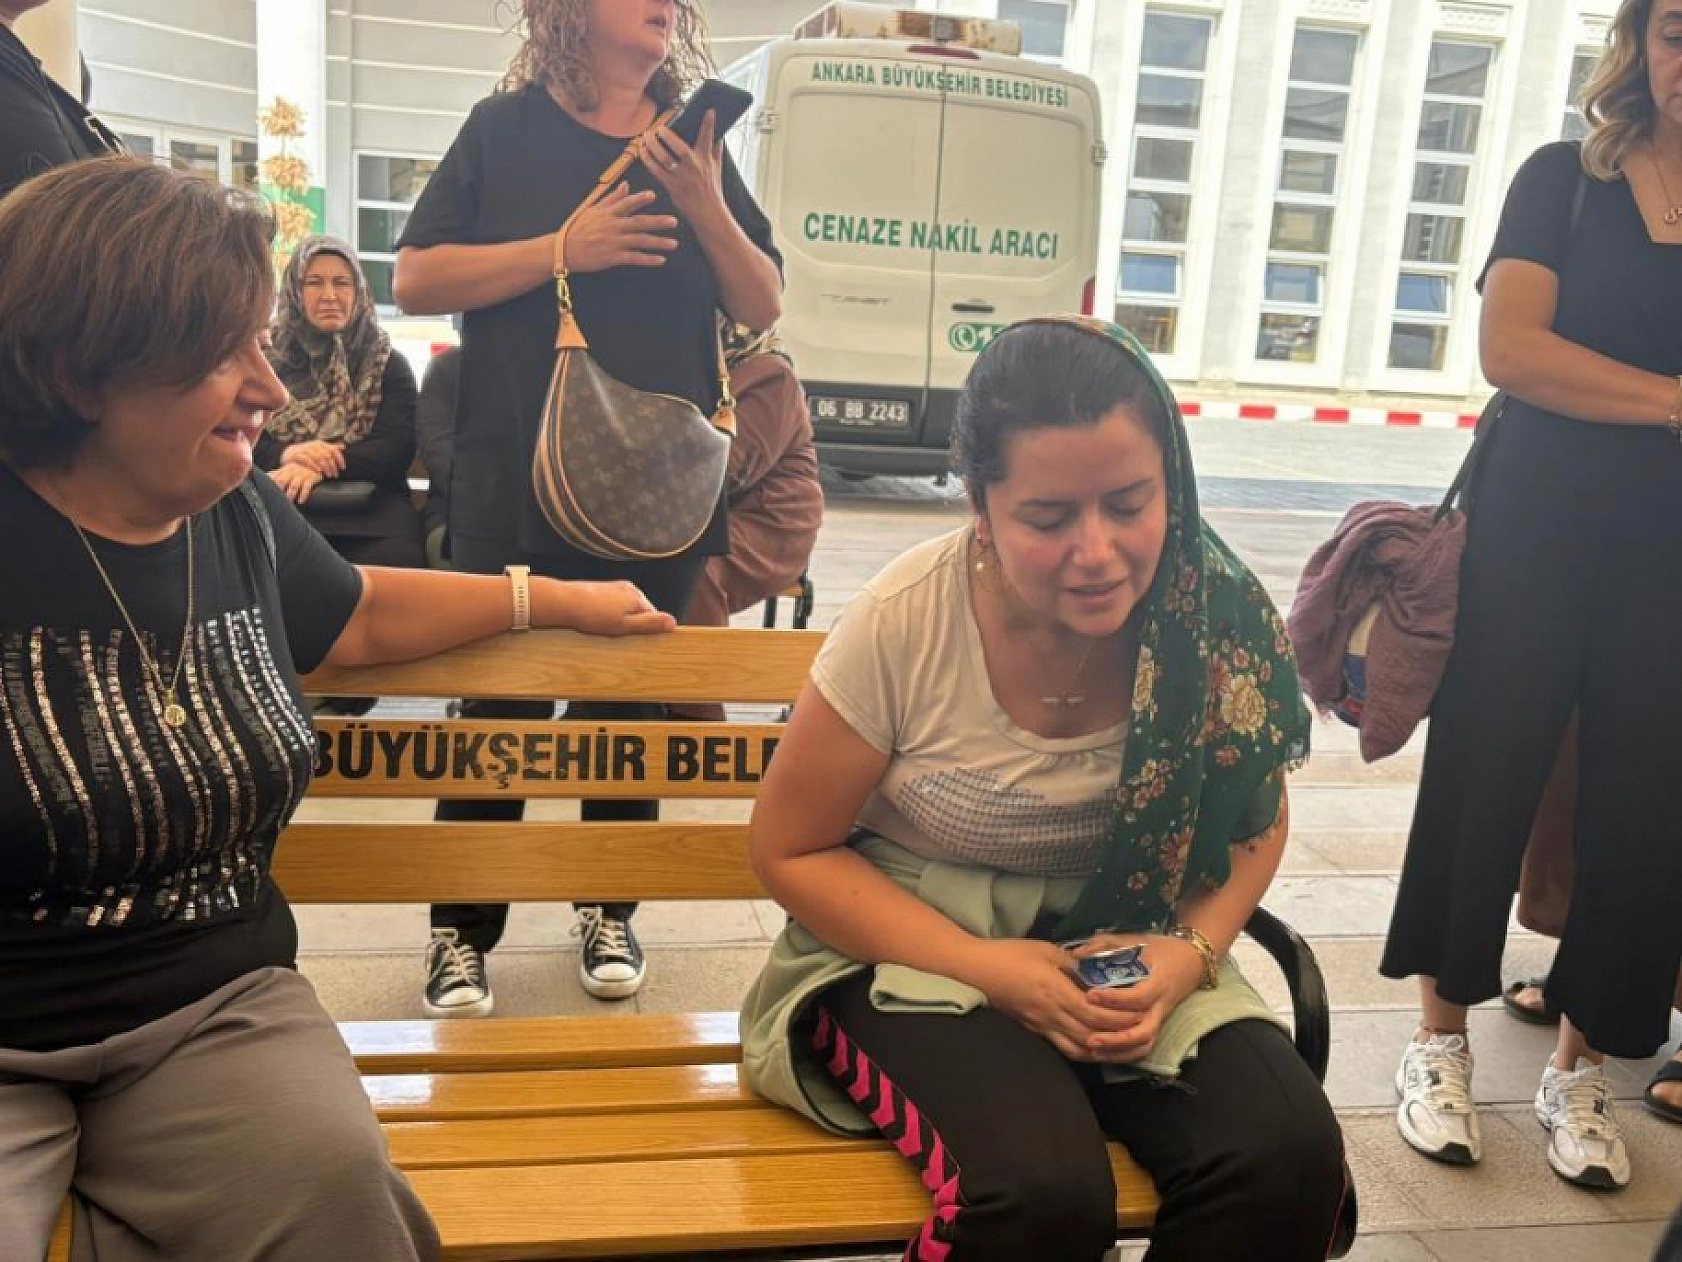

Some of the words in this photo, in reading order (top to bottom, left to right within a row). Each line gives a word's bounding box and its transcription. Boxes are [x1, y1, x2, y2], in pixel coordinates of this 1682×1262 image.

[812, 61, 875, 83] ANKARA
[881, 63, 981, 95] BÜYÜKŞEHİR
[985, 78, 1068, 108] BELEDİYESİ
[803, 212, 902, 246] CENAZE
[910, 219, 982, 253] NAKİL
[989, 228, 1059, 259] ARACI
[818, 400, 837, 417] 06
[314, 722, 646, 789] BÜYÜKŞEHİR
